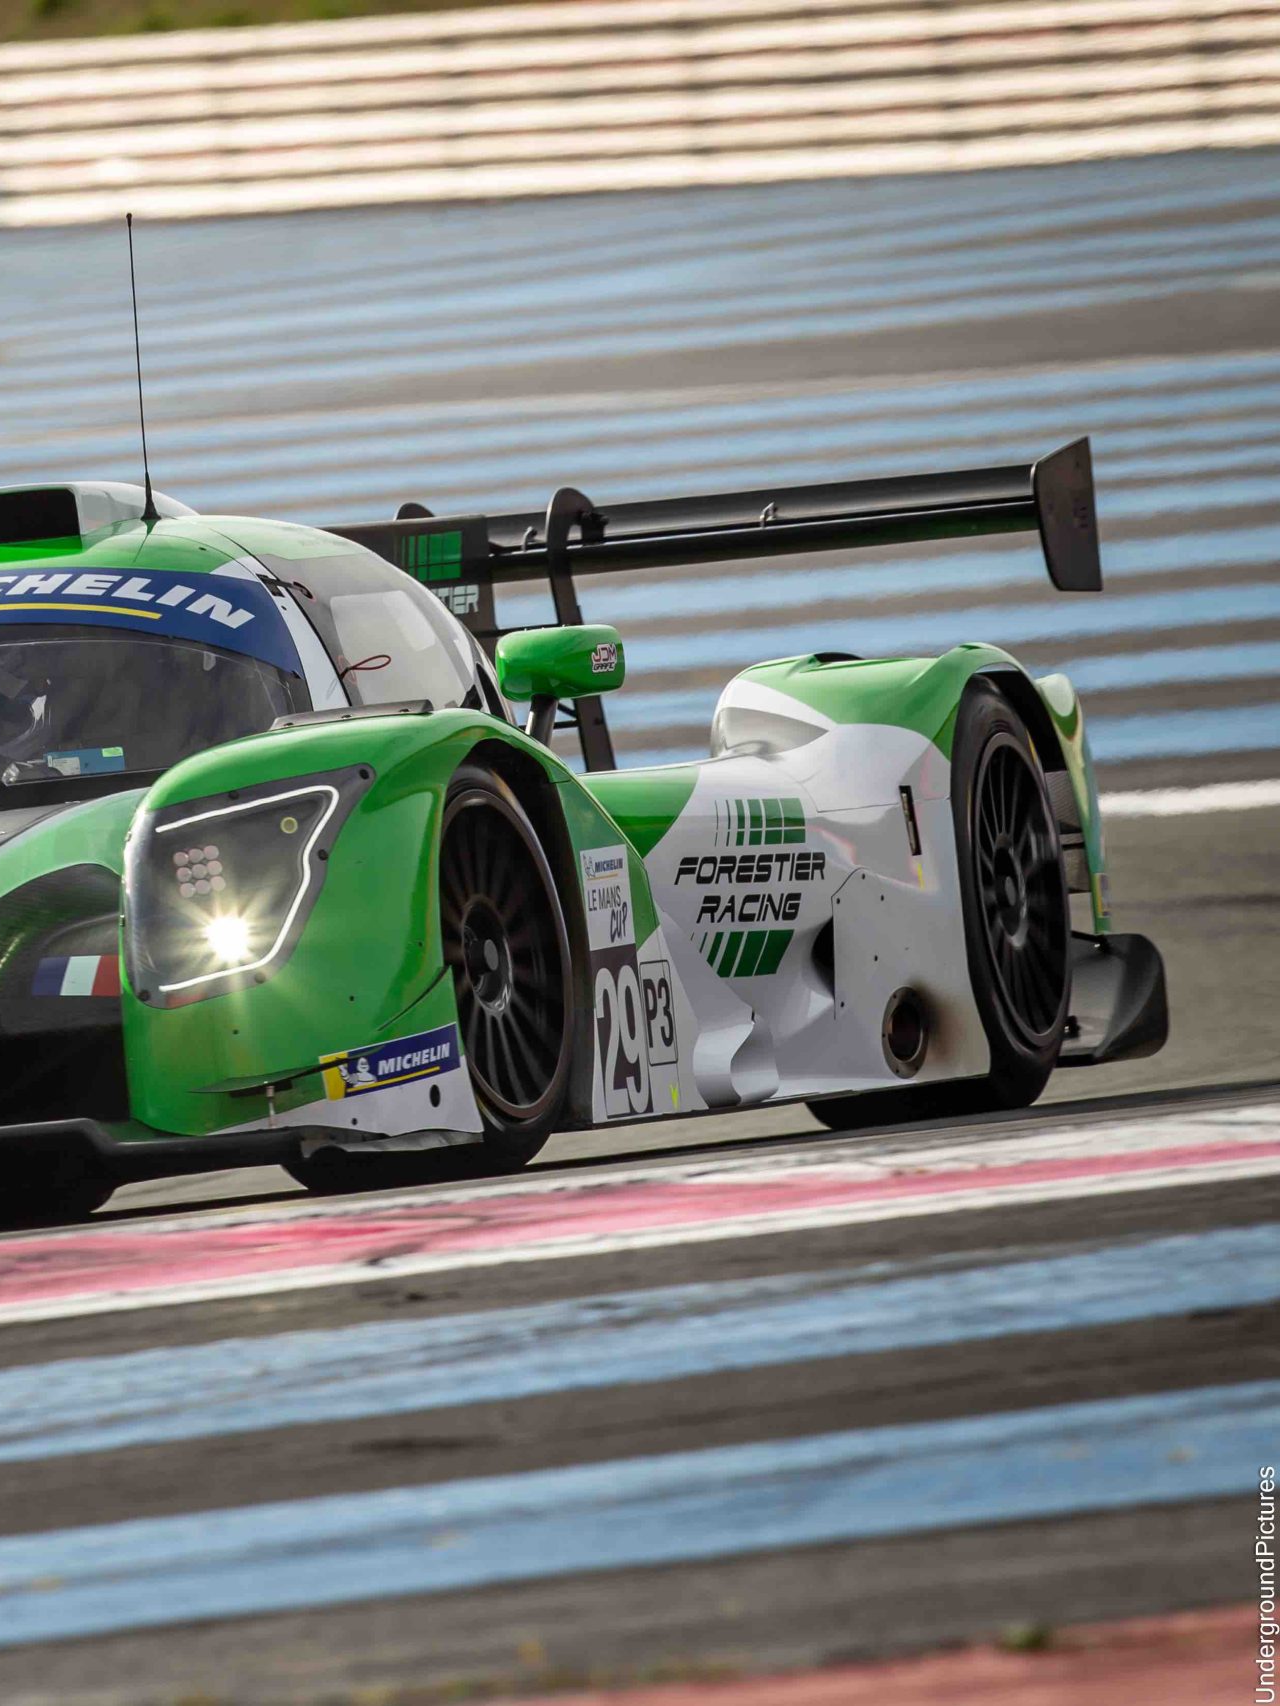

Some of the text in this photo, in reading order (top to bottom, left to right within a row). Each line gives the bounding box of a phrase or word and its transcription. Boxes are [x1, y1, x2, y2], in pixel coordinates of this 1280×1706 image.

[431, 584, 479, 614] TIER
[594, 857, 624, 873] MICHELIN
[674, 852, 826, 886] FORESTIER
[587, 885, 621, 912] LE MANS
[696, 892, 802, 924] RACING
[610, 901, 628, 943] CUP
[642, 977, 674, 1049] P3
[595, 964, 650, 1116] 29
[377, 1042, 451, 1076] MICHELIN
